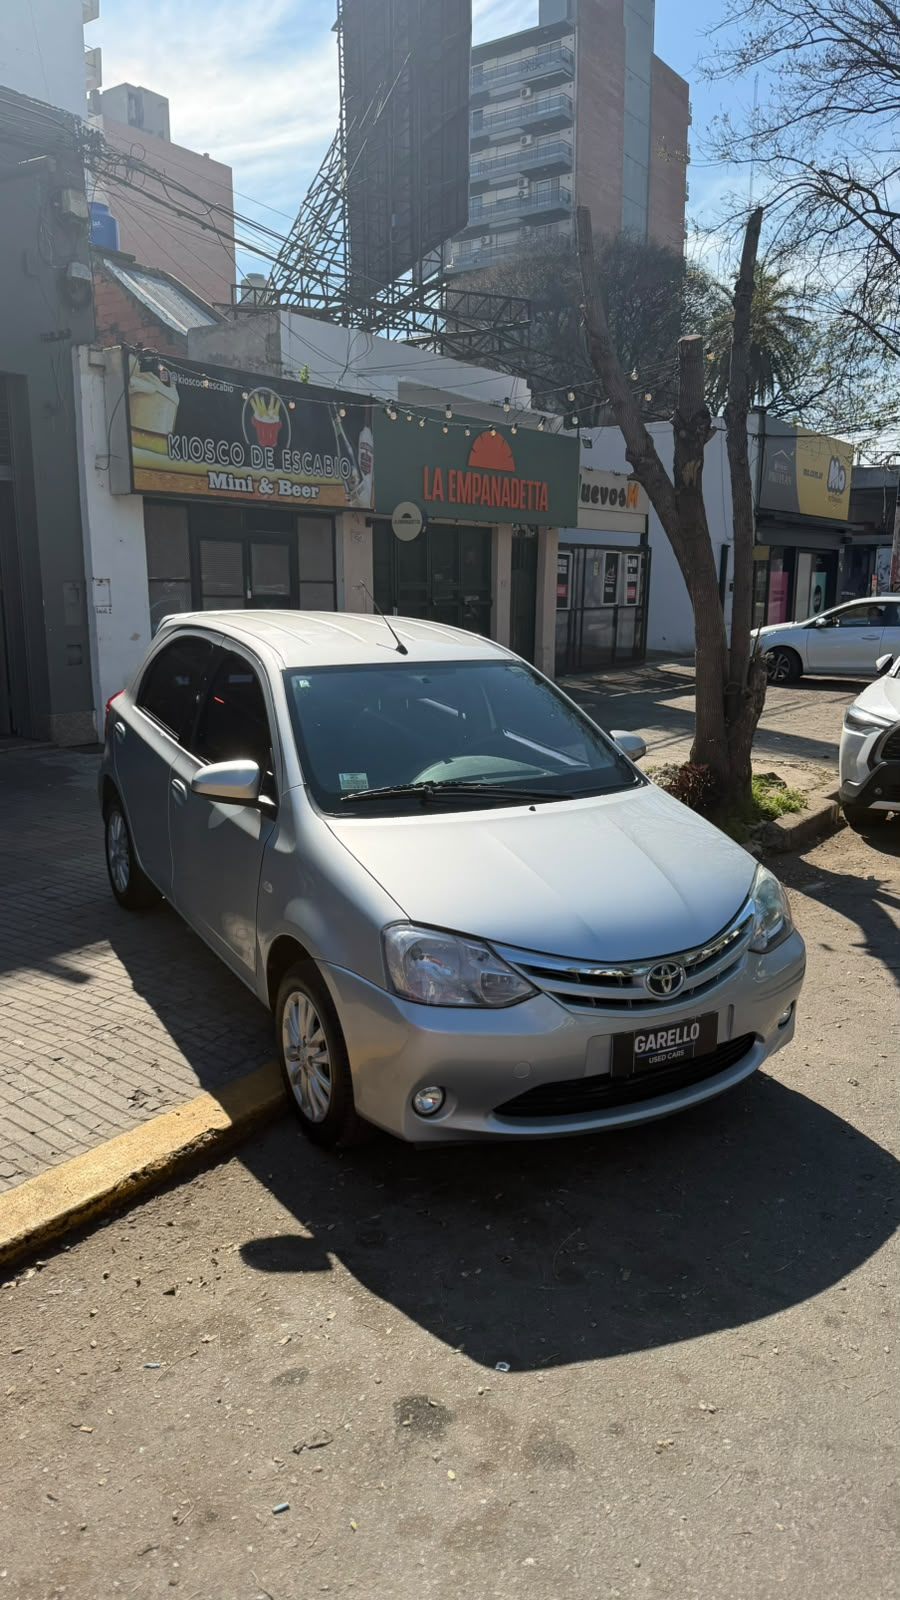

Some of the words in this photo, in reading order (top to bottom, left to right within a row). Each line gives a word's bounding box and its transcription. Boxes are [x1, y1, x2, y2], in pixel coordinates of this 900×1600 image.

[171, 371, 234, 393] @kioscodescabio
[167, 433, 245, 470] KIOSCO
[250, 444, 275, 471] DE
[281, 449, 351, 480] ESCABIO
[208, 471, 254, 494] Mini
[258, 478, 274, 495] &
[278, 480, 320, 499] Beer
[424, 465, 444, 501] LA
[448, 469, 548, 511] EMPANADETTA
[634, 1022, 700, 1053] GARELLO
[648, 1054, 667, 1064] USED
[667, 1049, 685, 1060] CARS
